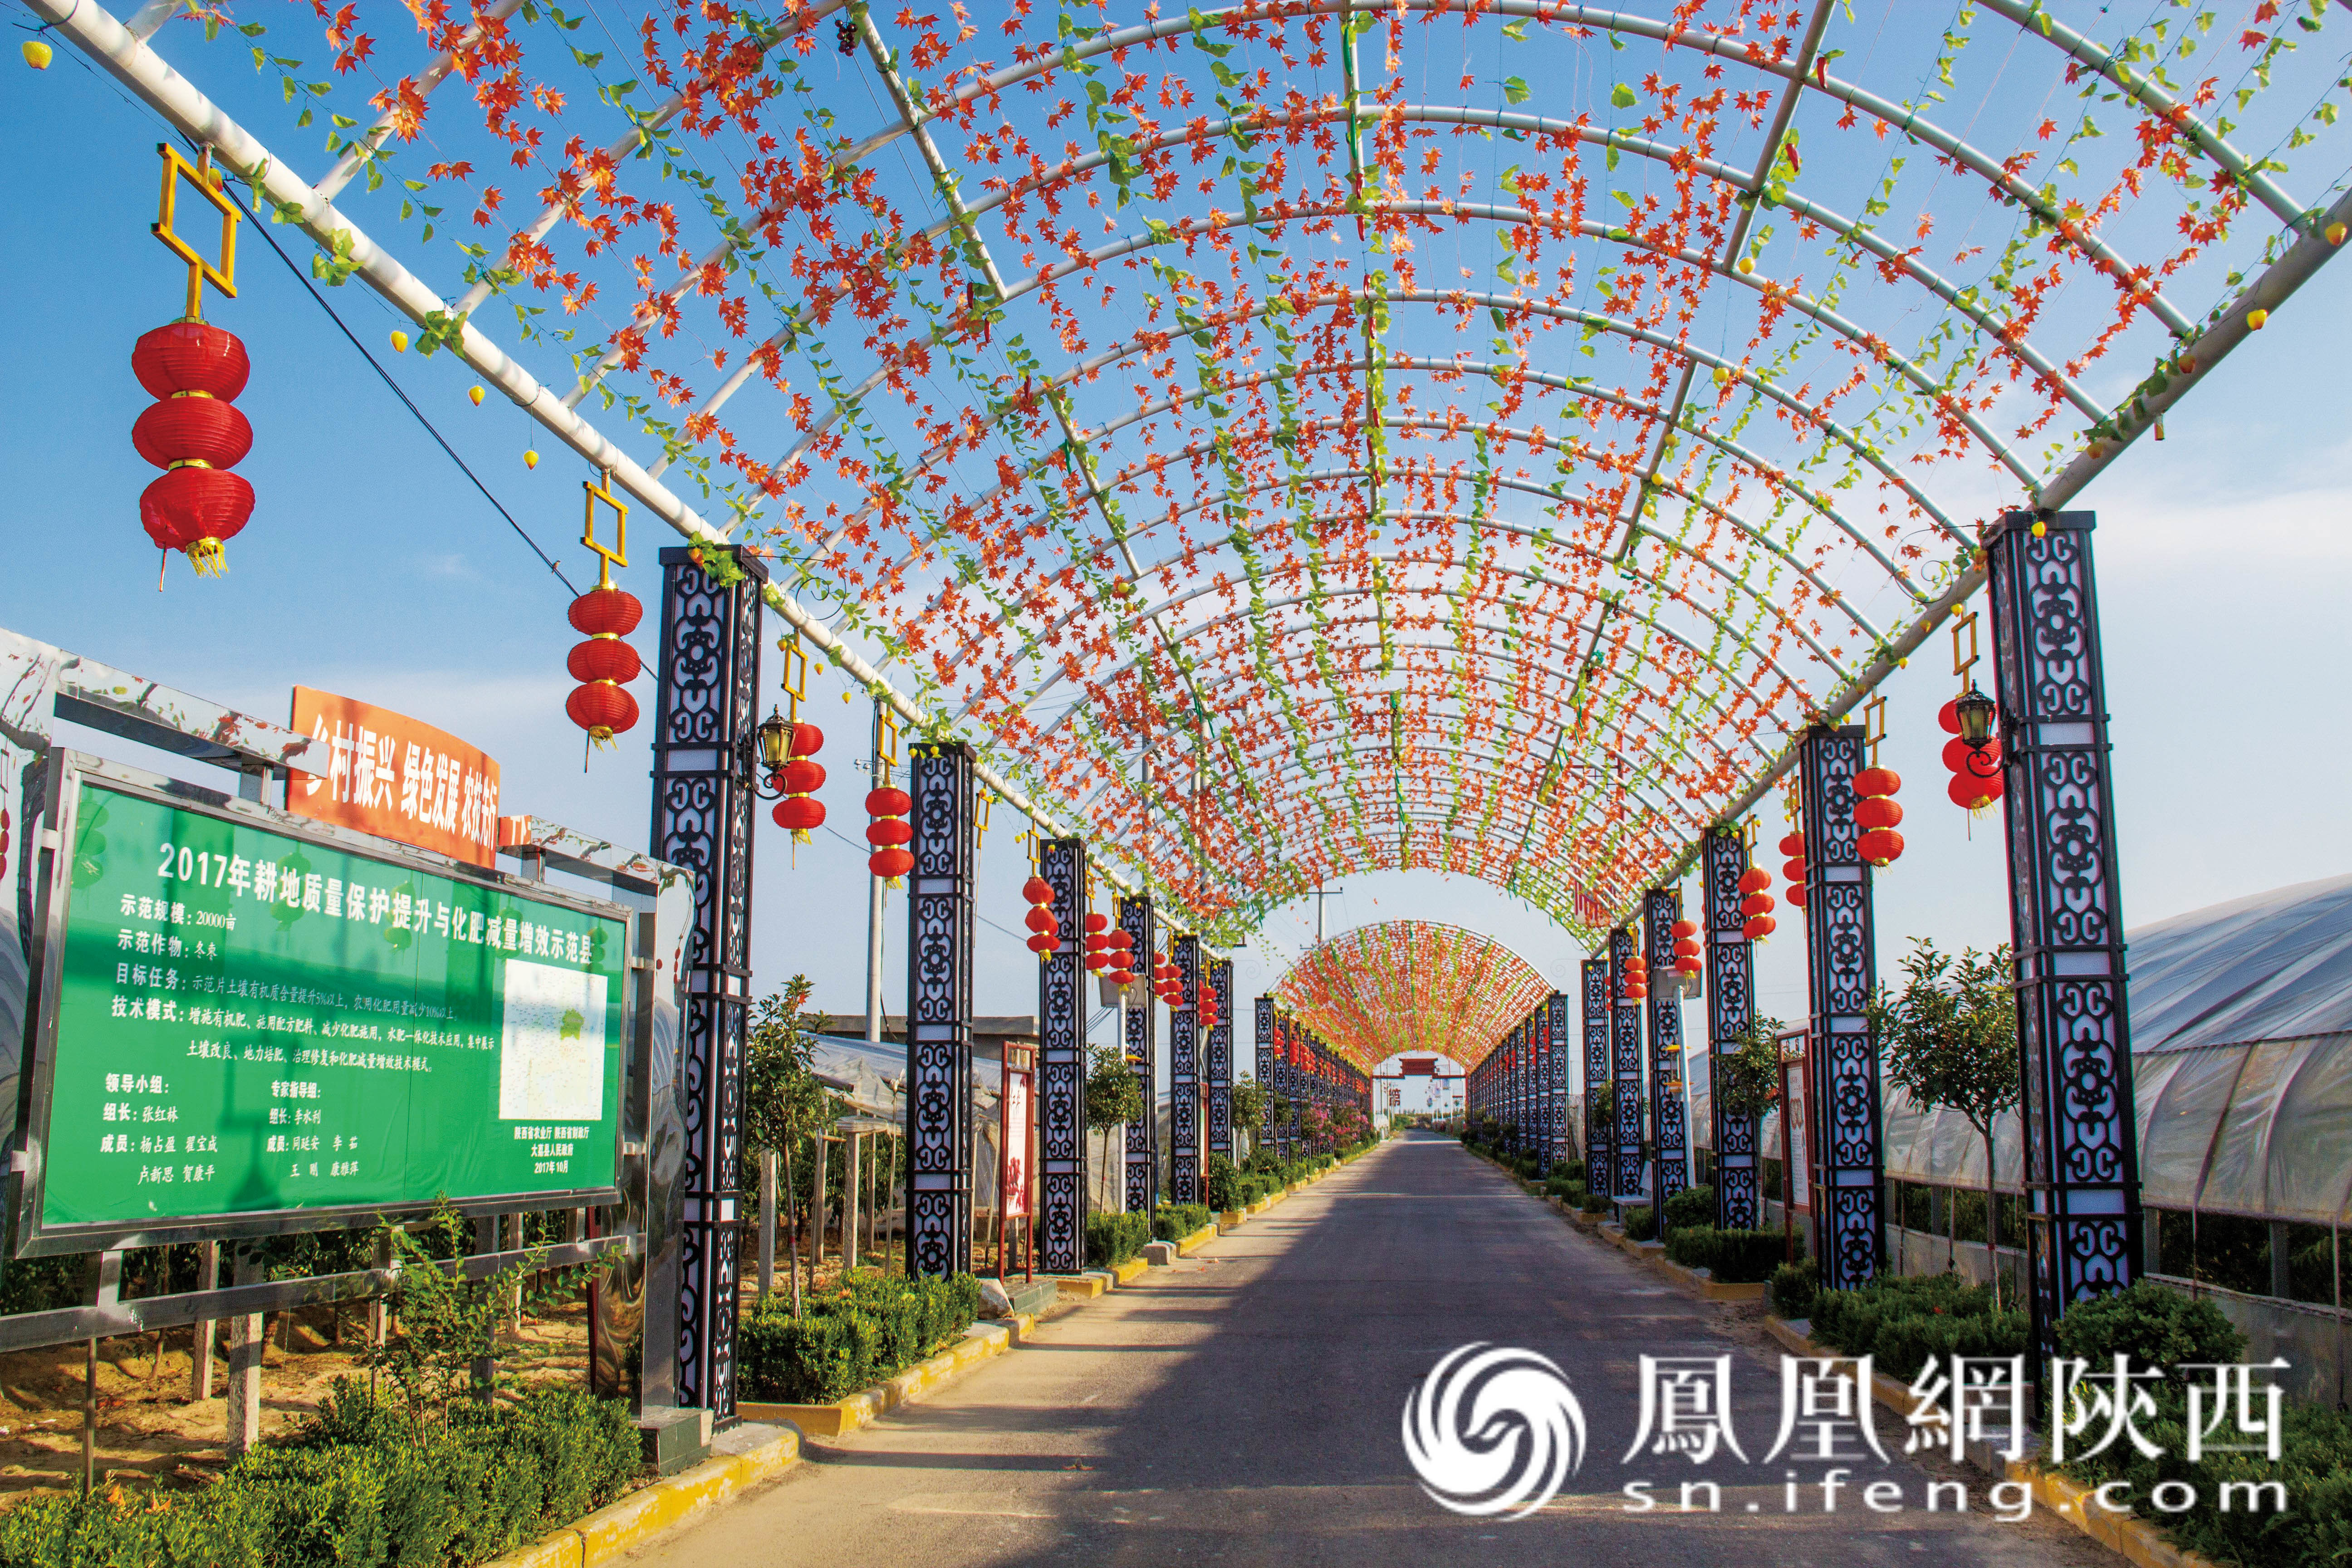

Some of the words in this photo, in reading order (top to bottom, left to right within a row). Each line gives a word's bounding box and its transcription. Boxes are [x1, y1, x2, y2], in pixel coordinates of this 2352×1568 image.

[401, 740, 461, 835] 绿色发展
[462, 766, 497, 851] 农技先行
[157, 843, 592, 964] 2017年耕地质量保护提升与化肥减量增效示范县
[105, 1073, 169, 1093] 领导小组：
[271, 1080, 320, 1098] 专家指导组：
